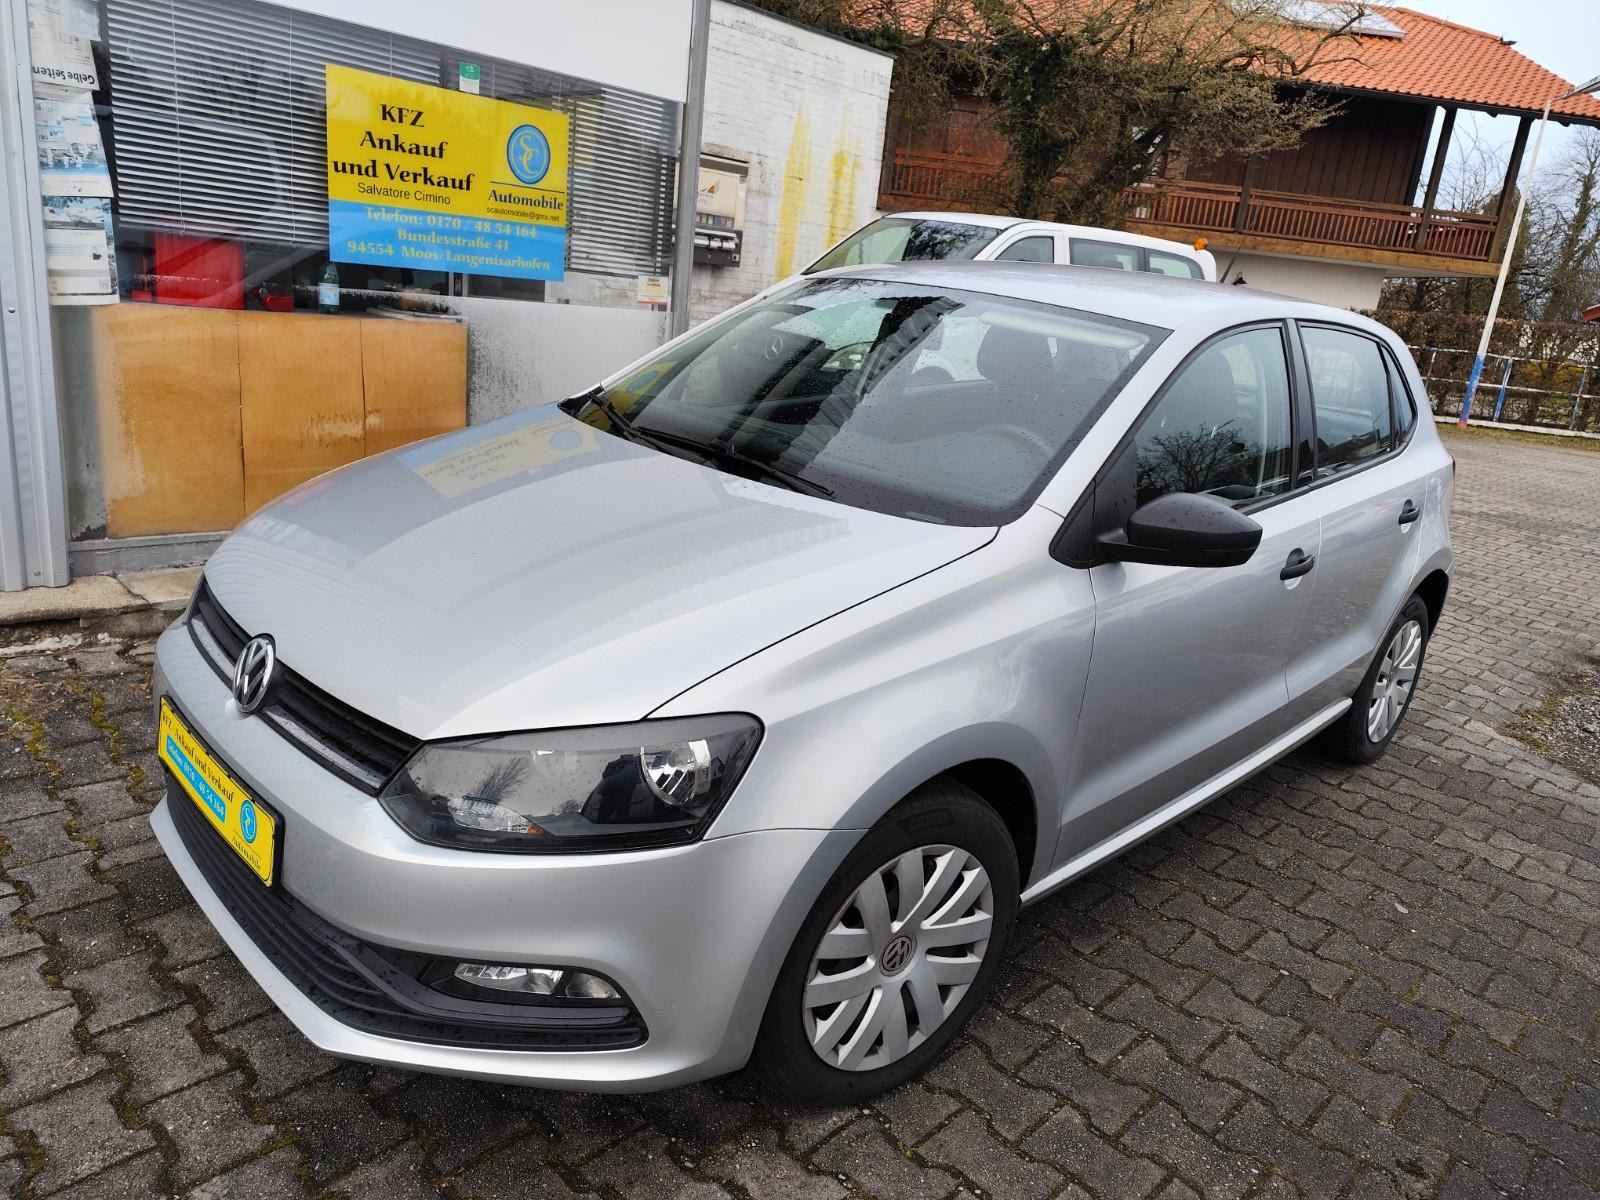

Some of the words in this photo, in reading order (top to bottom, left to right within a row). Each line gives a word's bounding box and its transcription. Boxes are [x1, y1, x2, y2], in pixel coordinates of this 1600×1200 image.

[32, 65, 66, 80] Seiten
[67, 71, 96, 85] Gelbe
[378, 103, 425, 128] KFZ
[359, 130, 449, 159] Ankauf
[332, 159, 379, 178] und
[384, 162, 475, 191] Verkauf
[357, 181, 411, 201] Salvatore
[413, 189, 451, 206] Cimino
[487, 189, 564, 211] Automobile
[366, 207, 423, 225] Telefon:
[426, 214, 462, 229] 0170
[474, 220, 491, 233] 48
[495, 222, 512, 236] 54
[515, 224, 538, 238] 164
[346, 239, 395, 256] 94554
[397, 228, 492, 250] Bundesstraße
[495, 239, 509, 251] 41
[208, 765, 235, 804] Verkauf
